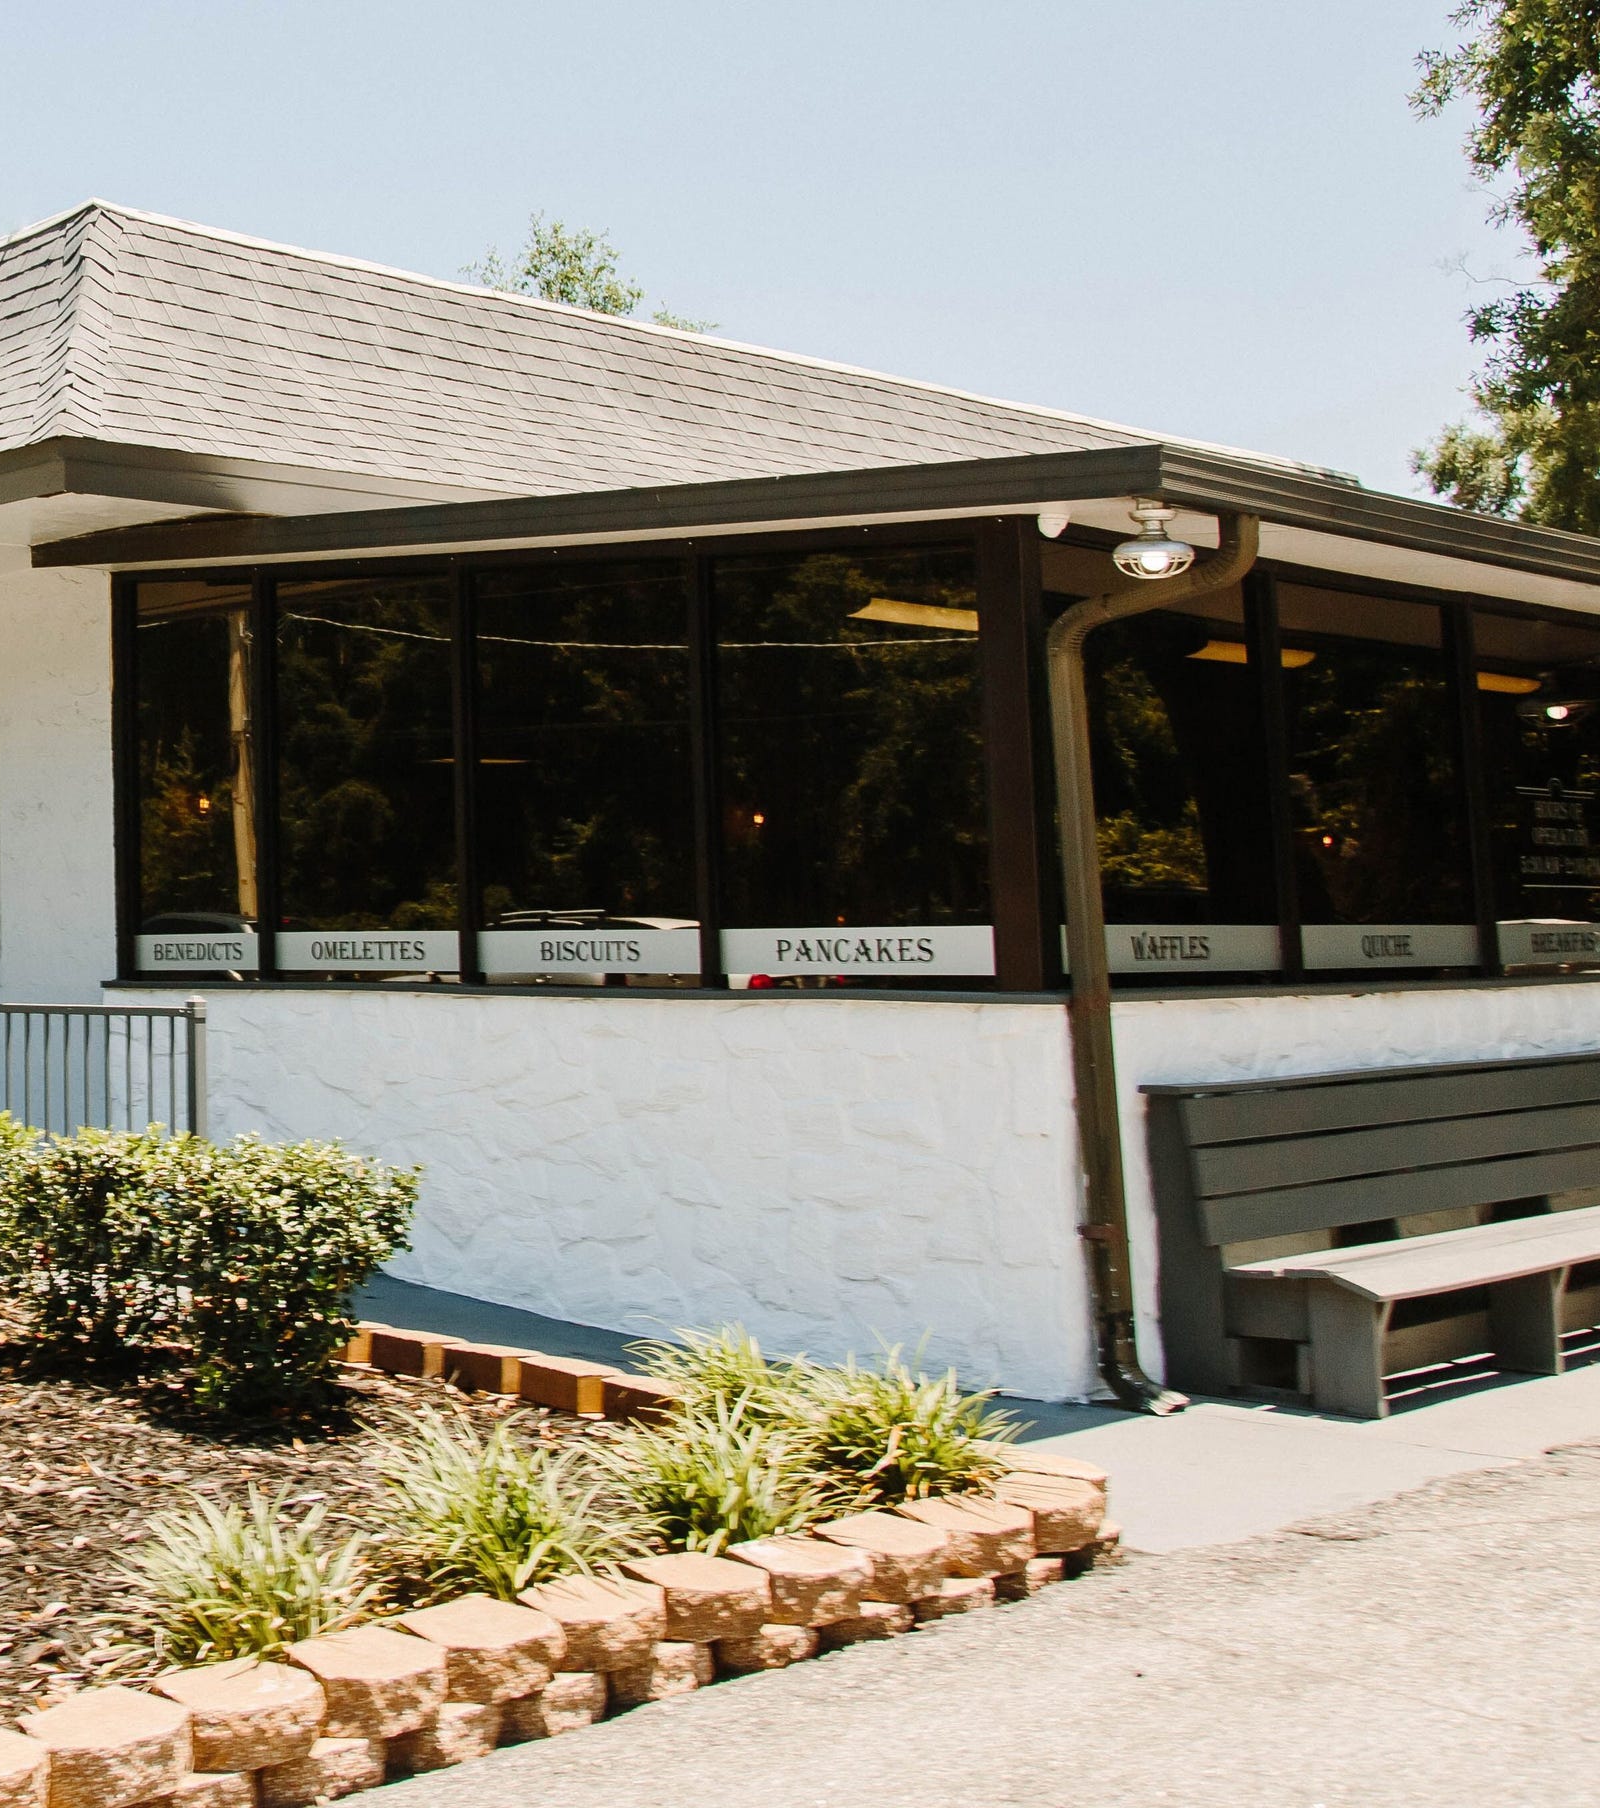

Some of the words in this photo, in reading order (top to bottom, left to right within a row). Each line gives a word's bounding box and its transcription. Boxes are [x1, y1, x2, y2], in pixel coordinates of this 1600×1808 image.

[153, 941, 244, 961] BENEDICTS
[311, 940, 425, 961] OMELETTES
[540, 940, 641, 962] BISCUITS
[775, 937, 935, 963] PANCAKES
[1130, 933, 1211, 961] WAFFLES
